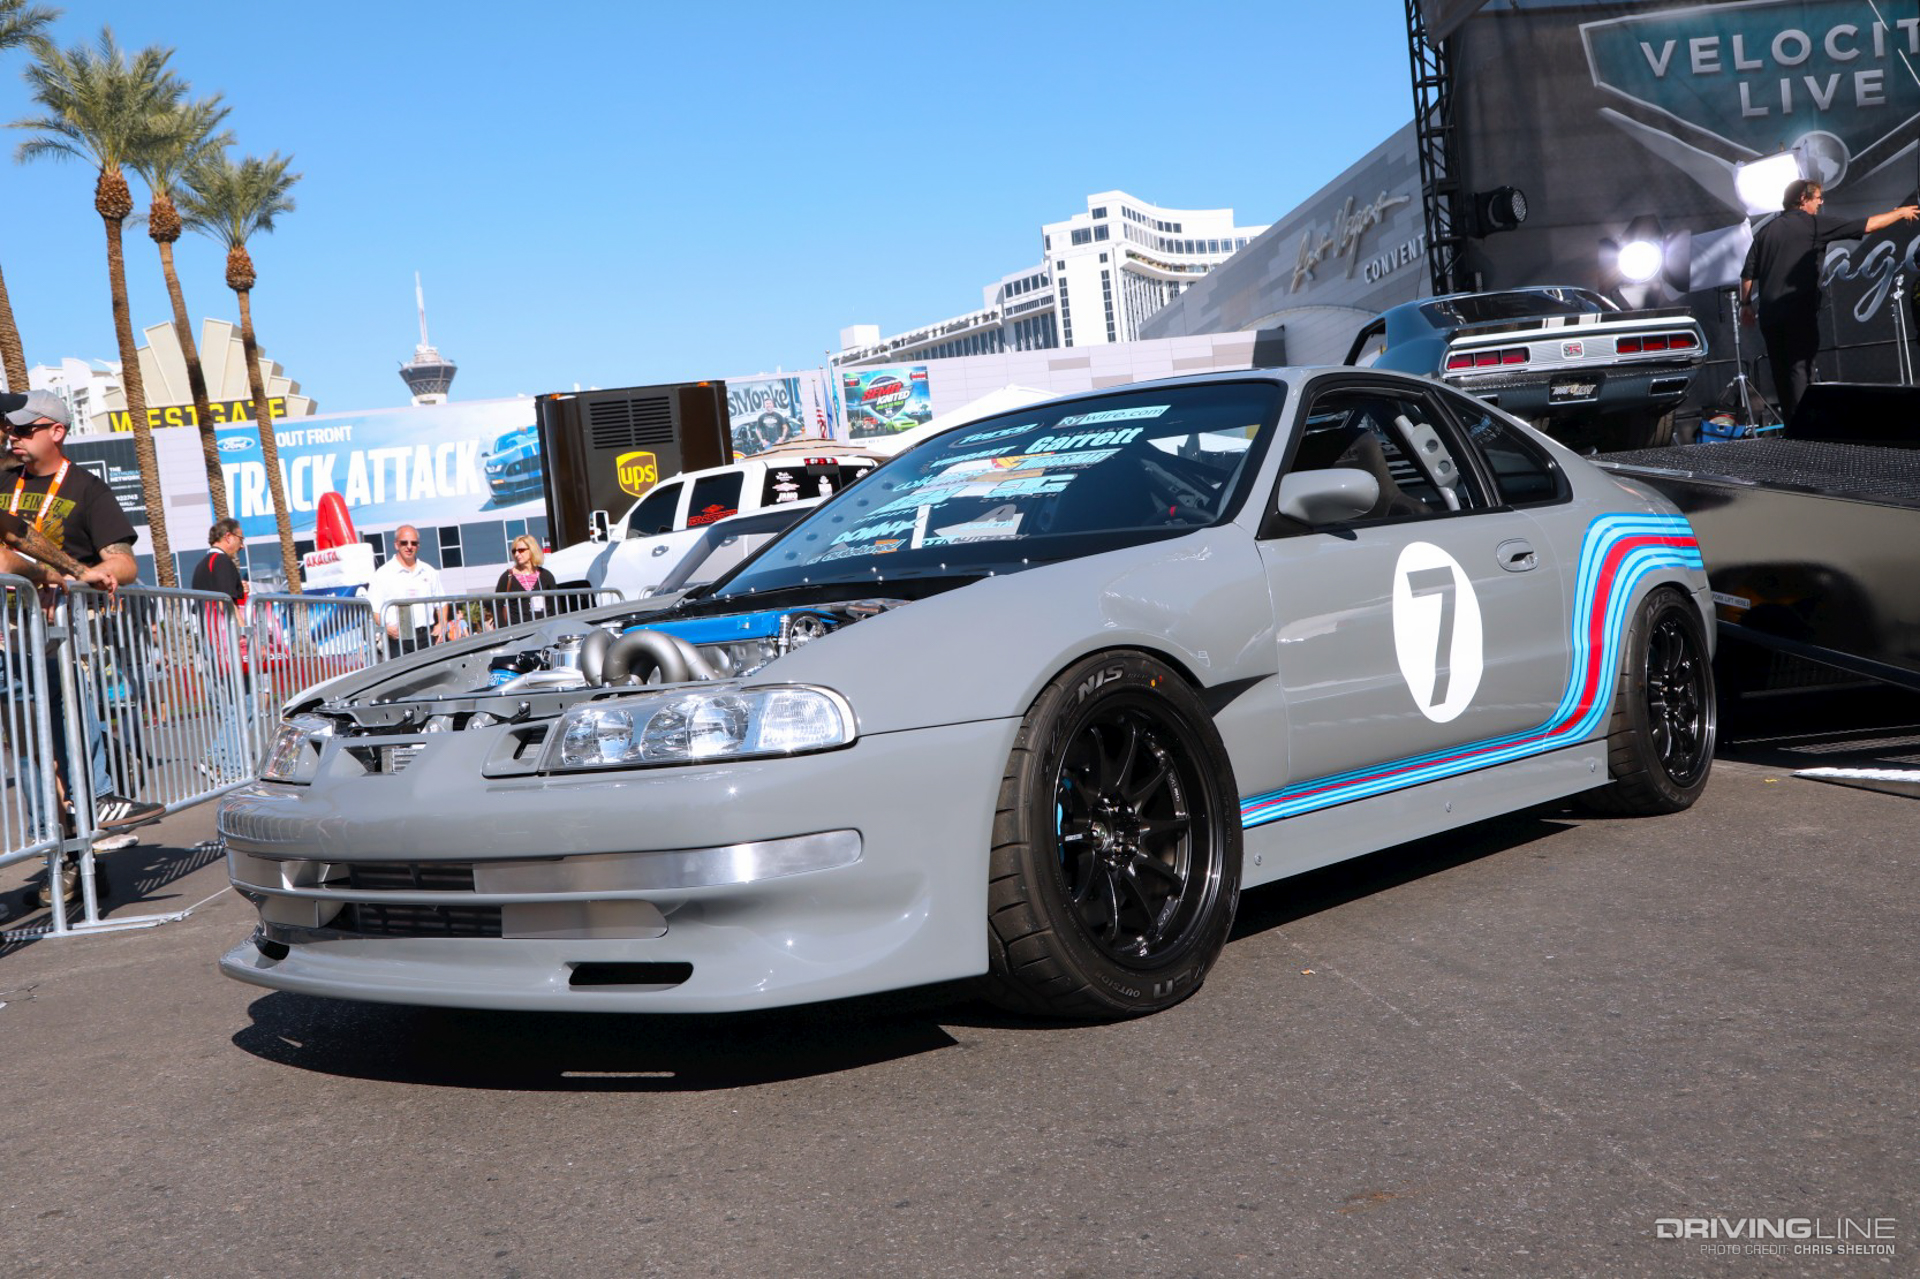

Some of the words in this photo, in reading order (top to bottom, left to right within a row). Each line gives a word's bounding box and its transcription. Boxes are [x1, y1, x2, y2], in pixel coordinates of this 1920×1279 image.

[1739, 69, 1886, 117] LIVE
[1364, 233, 1426, 284] CONVENT
[222, 439, 248, 450] Ford
[275, 431, 304, 447] OUT
[306, 425, 353, 444] FRONT
[1024, 427, 1144, 454] Garrett
[345, 439, 481, 504] ATTACK
[620, 464, 656, 491] ups
[1406, 565, 1457, 707] 7
